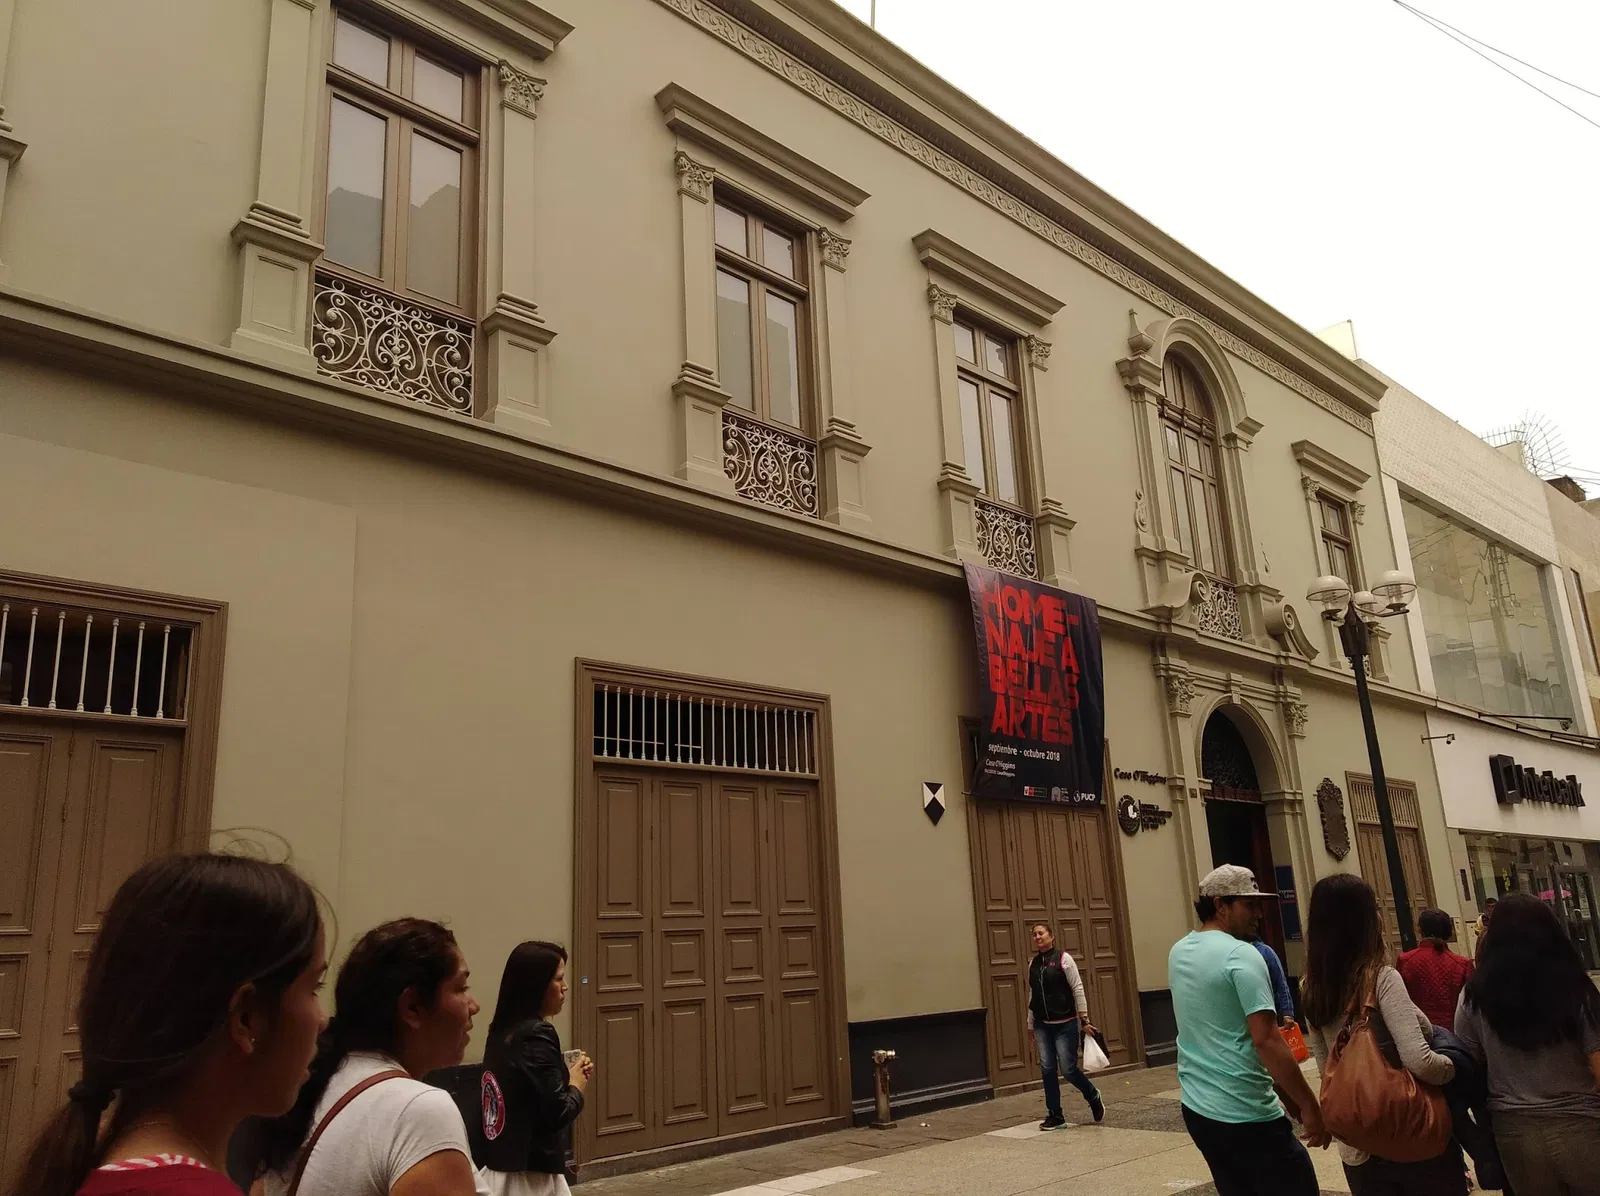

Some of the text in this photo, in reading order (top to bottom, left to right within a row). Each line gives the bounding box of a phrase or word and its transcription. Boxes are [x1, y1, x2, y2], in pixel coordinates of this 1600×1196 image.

[1061, 636, 1080, 675] A
[988, 653, 1079, 709] BELLAS
[990, 694, 1073, 745] ARTES
[988, 743, 1018, 756] septiembre
[1023, 749, 1046, 760] octubre
[1046, 750, 1061, 762] 2018
[1081, 792, 1096, 801] PUCP
